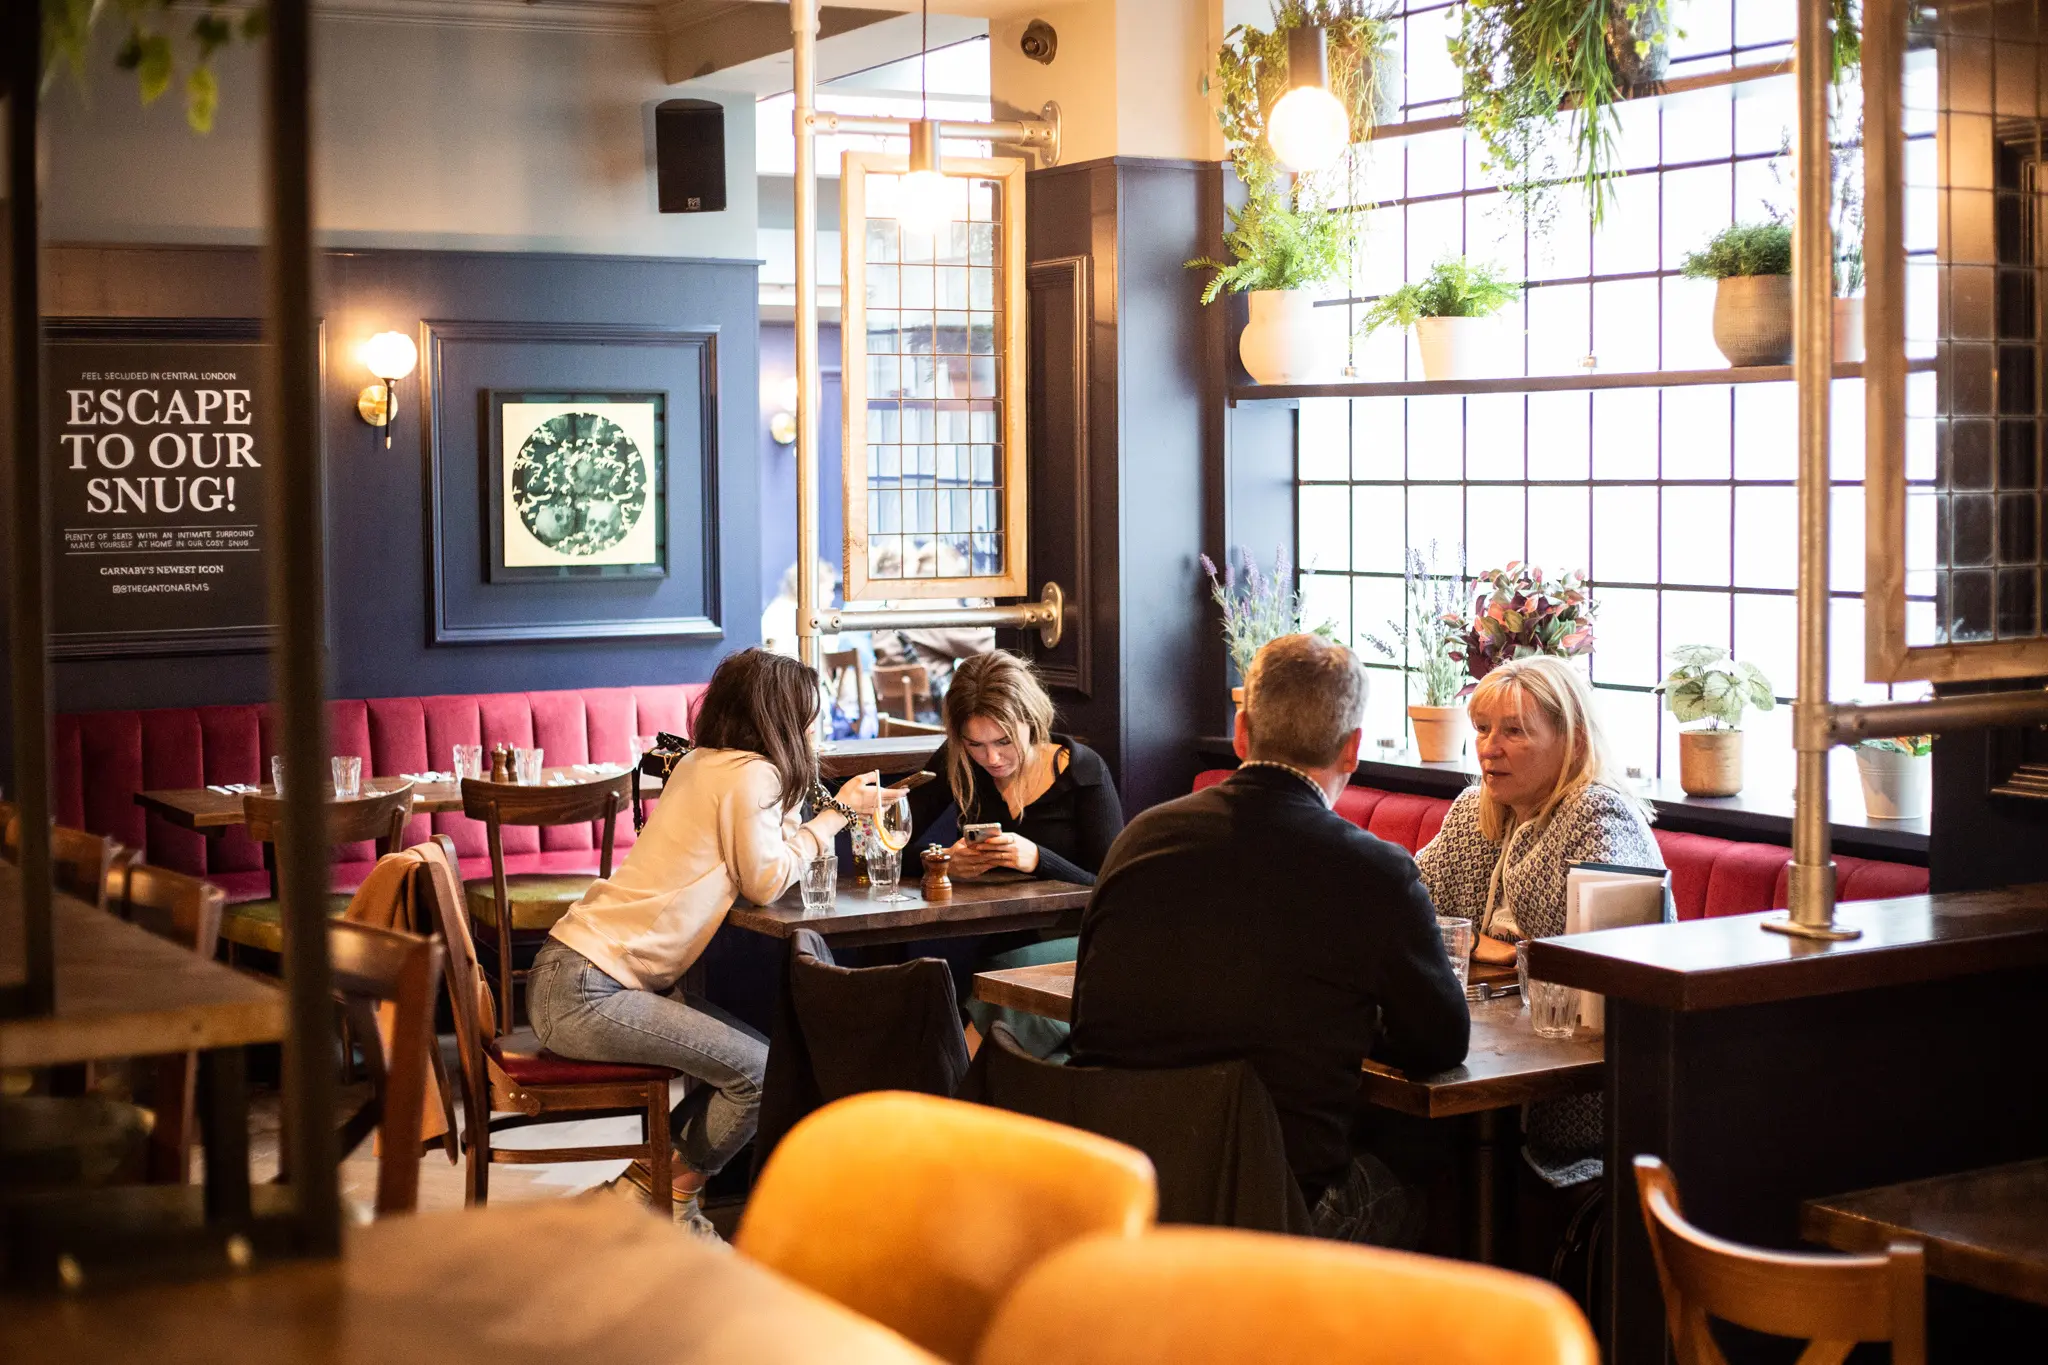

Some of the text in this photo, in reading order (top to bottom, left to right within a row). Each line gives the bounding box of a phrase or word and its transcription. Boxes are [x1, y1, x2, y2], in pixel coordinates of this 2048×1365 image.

[81, 372, 237, 380] FEEL SECLUDED IN CENTRAL LONDON
[66, 389, 252, 425] ESCAPE
[60, 432, 262, 470] TO OUR
[87, 476, 236, 514] SNUG!
[65, 533, 93, 541] PLENTY
[97, 532, 108, 540] OF
[112, 532, 133, 540] SEATS
[162, 531, 173, 539] AN
[177, 531, 212, 539] INTIMATE
[215, 530, 255, 538] SURROUND
[70, 541, 95, 549] MAKE
[99, 541, 133, 549] YOURSELF
[137, 540, 147, 548] AT
[150, 540, 172, 548] HOME
[228, 539, 249, 547] SNUG
[100, 565, 224, 575] CARNABY'S NEWEST ICON
